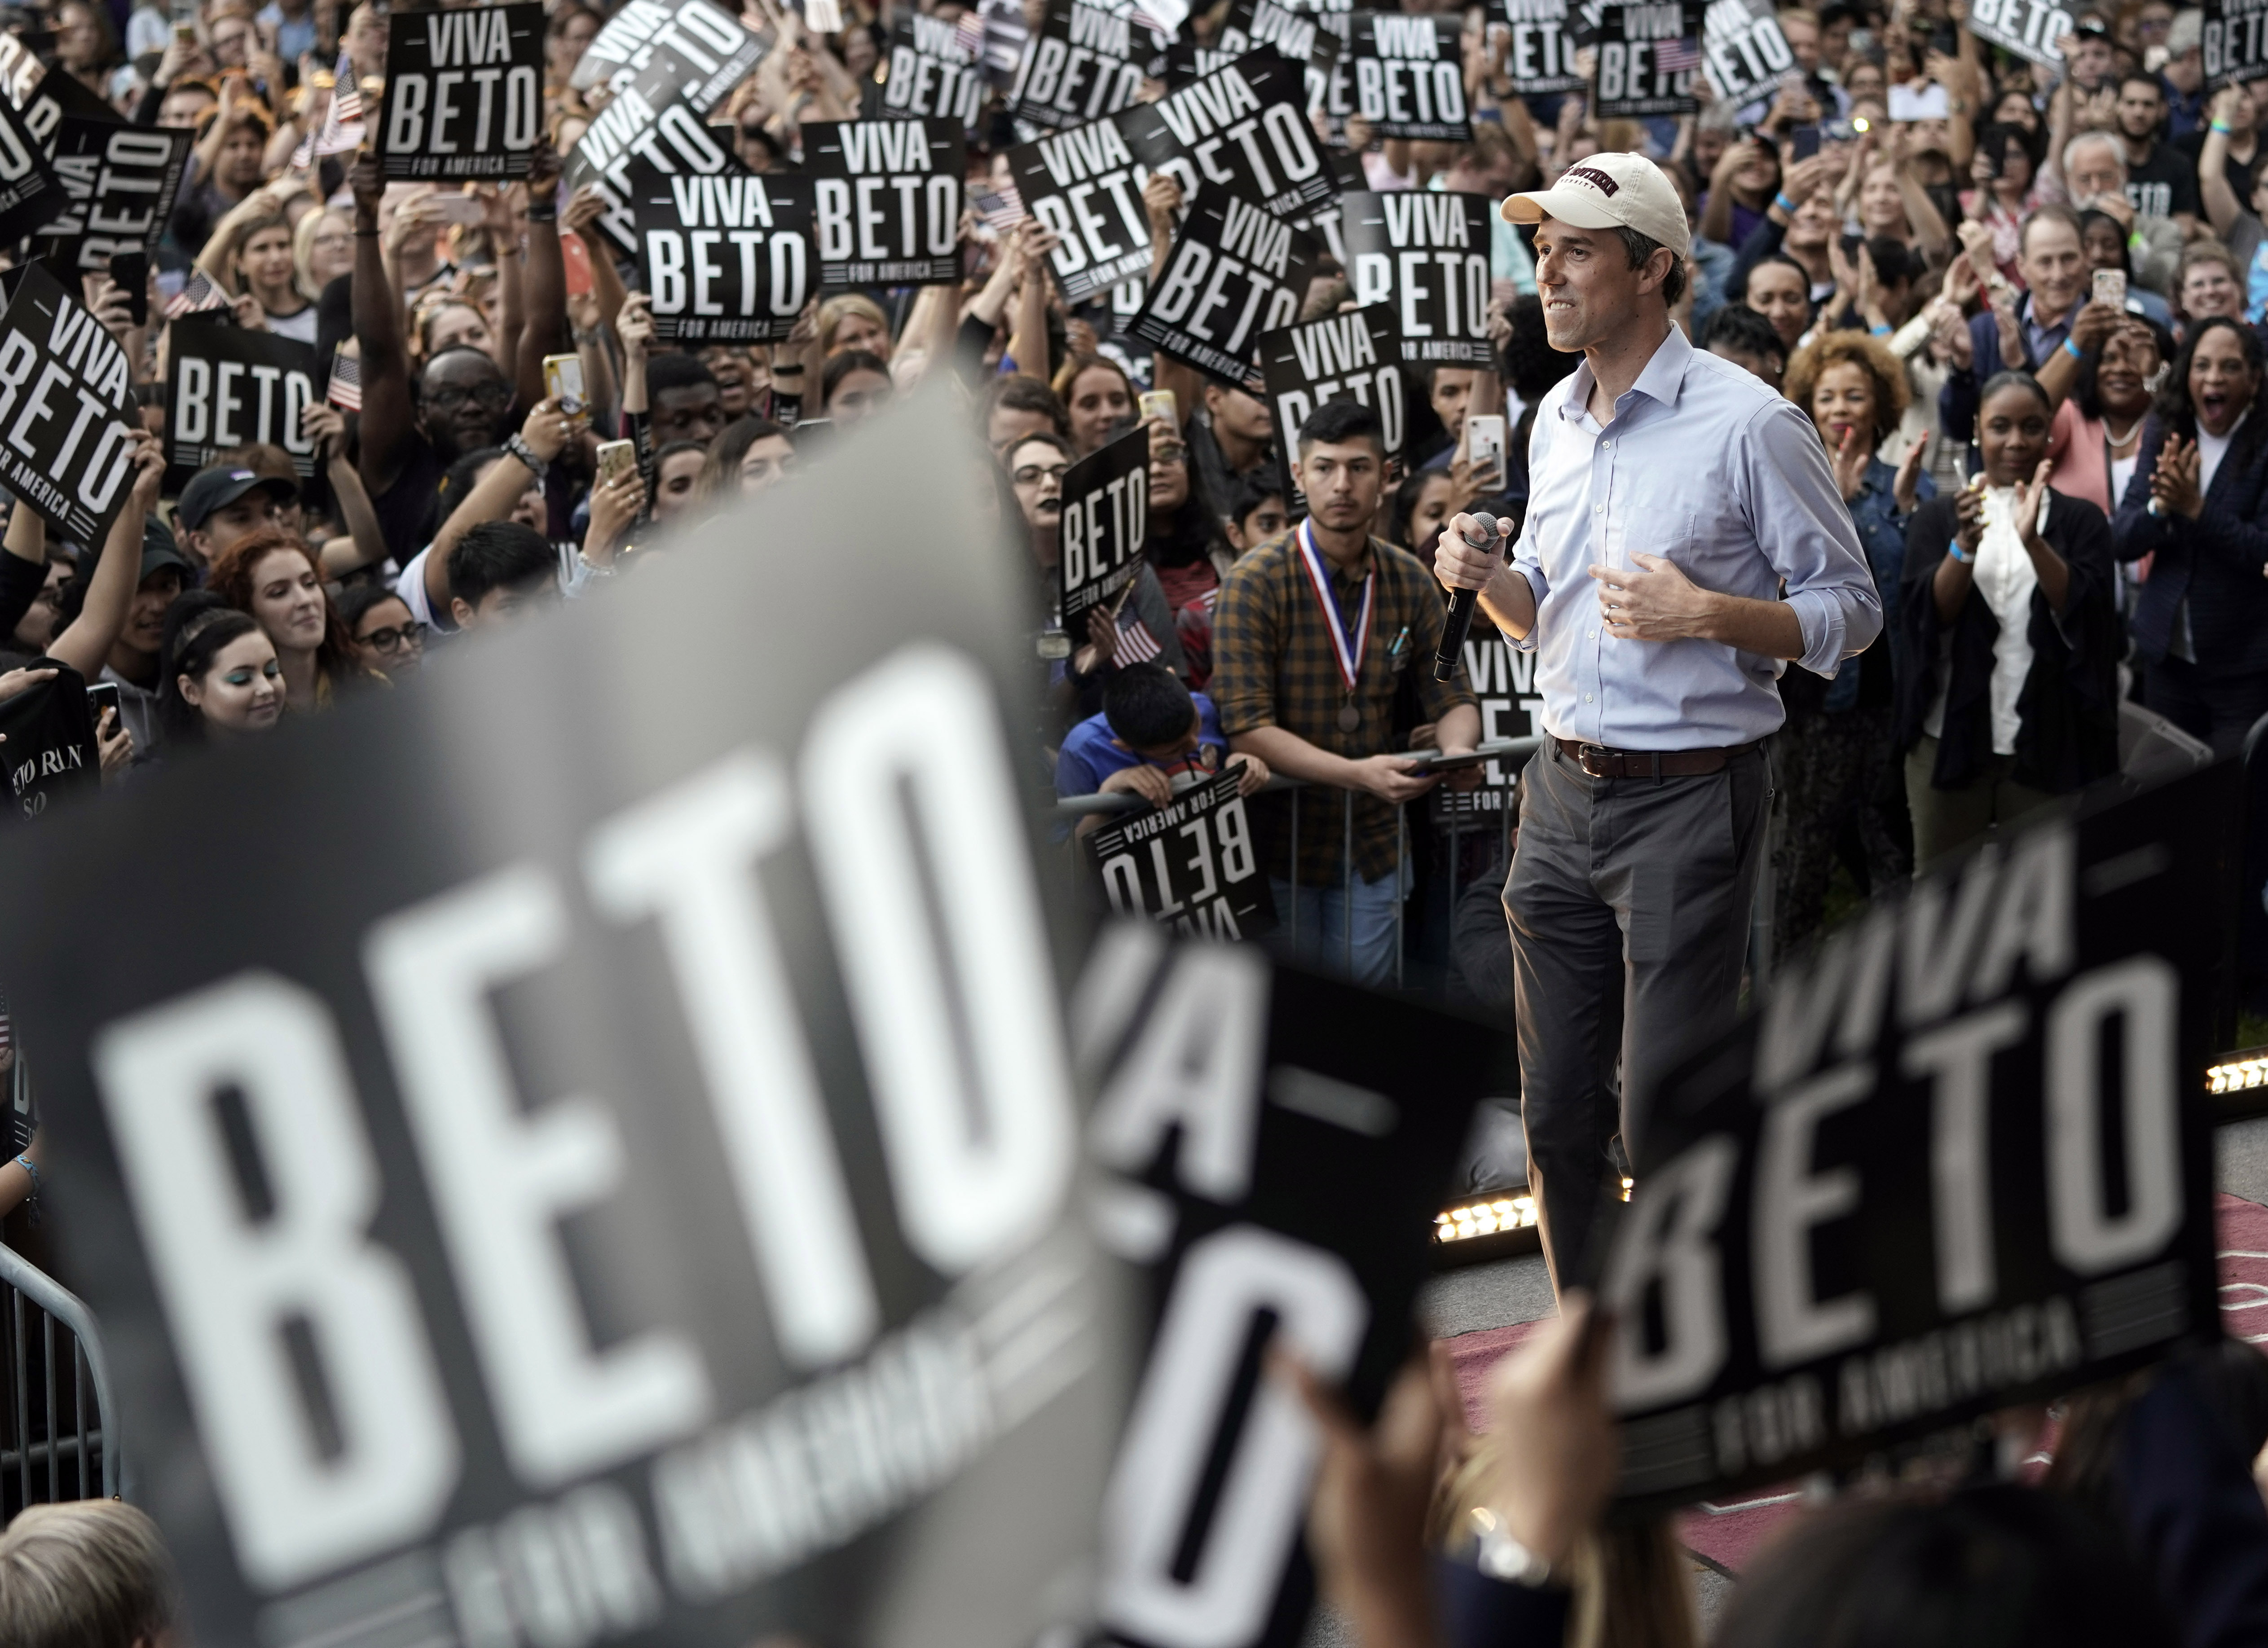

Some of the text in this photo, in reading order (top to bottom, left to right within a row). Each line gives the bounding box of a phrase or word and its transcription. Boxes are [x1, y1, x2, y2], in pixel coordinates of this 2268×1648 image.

[427, 9, 512, 68] VIVA
[1069, 2, 1131, 61] VIVA
[1373, 15, 1439, 60] VIVA
[1702, 16, 1793, 101] ETO
[385, 66, 537, 154] BETO
[885, 45, 985, 127] BETO
[1028, 35, 1146, 120] BETO
[1155, 65, 1261, 147] VIVA
[1356, 57, 1466, 124] BETO
[412, 155, 505, 176] FOR AMERICA
[578, 85, 656, 172] VIVA
[838, 119, 933, 175] VIVA
[1038, 117, 1134, 187] VIVA
[76, 130, 173, 269] BETO
[671, 176, 774, 227] VIVA
[815, 175, 959, 262] BETO
[1219, 195, 1292, 279] VIVA
[1382, 193, 1471, 250] VIVA
[646, 229, 807, 316] BETO
[848, 262, 875, 284] FOR
[1149, 239, 1298, 354] BETO
[1355, 250, 1491, 339] BETO
[48, 294, 129, 411] VIVA
[677, 319, 771, 338] FOR AMERICA
[1290, 311, 1378, 382] VIVA
[0, 327, 137, 514] BETO
[175, 357, 317, 454] BETO
[1277, 365, 1404, 480] BO
[10, 461, 72, 521] AMERICA
[1064, 466, 1145, 593] BETO
[1463, 639, 1543, 694] VIV
[1123, 787, 1216, 844] FOR AMERICA
[1472, 791, 1502, 811] FOR
[1102, 797, 1257, 923] BETO
[1749, 815, 2083, 1100] VIVA
[90, 640, 1078, 1598] BETO
[1605, 949, 2189, 1416] BETO
